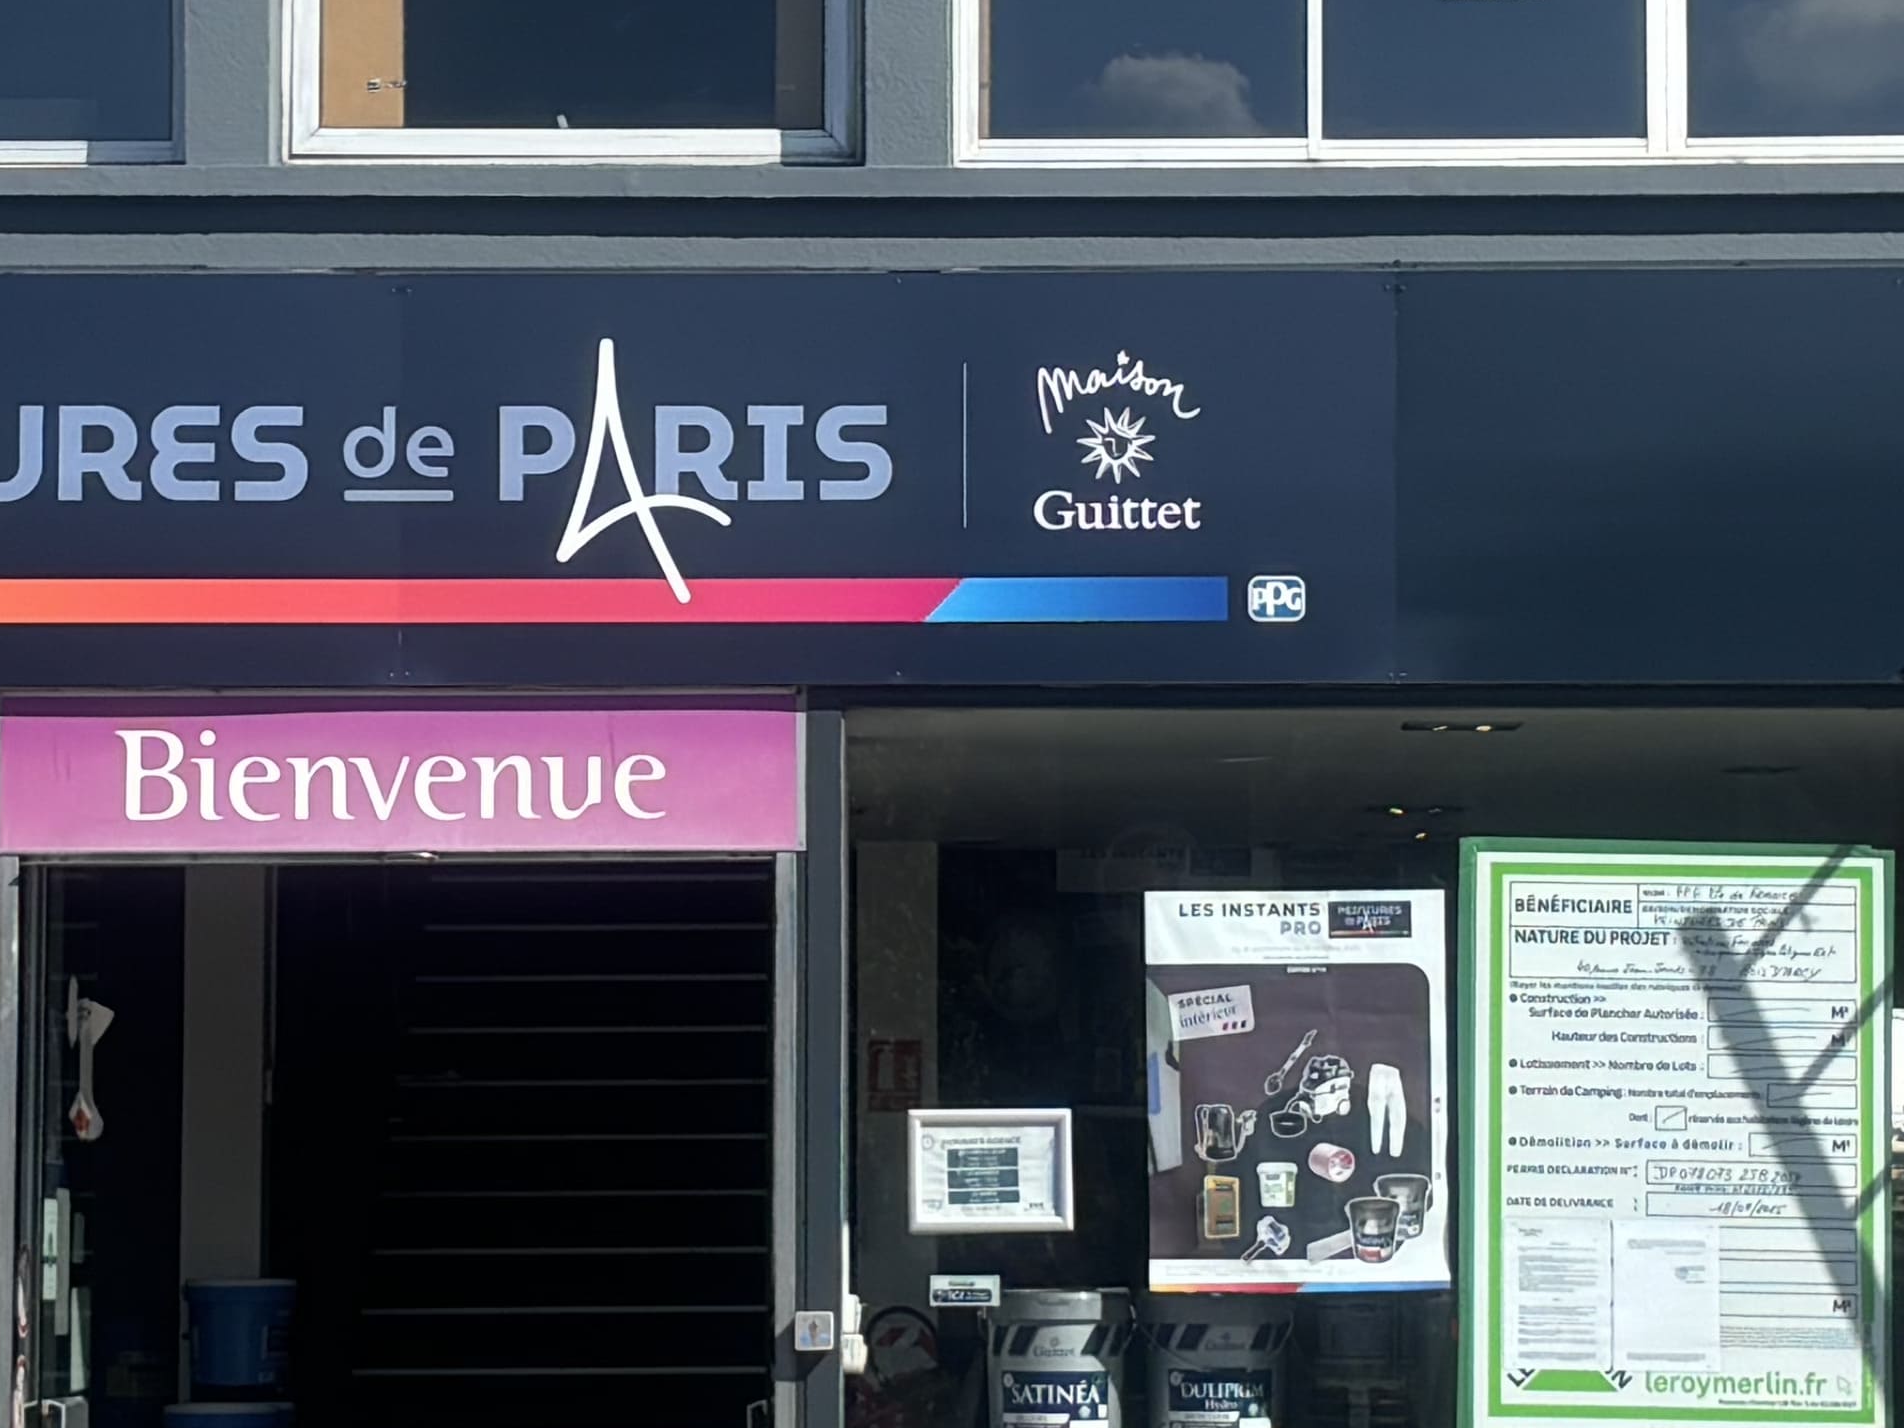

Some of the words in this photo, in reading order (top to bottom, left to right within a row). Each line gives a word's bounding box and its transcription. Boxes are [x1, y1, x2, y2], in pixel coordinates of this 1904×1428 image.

[343, 422, 455, 486] de
[501, 337, 894, 605] PARIS
[1032, 489, 1202, 531] Guittet
[1251, 580, 1302, 617] PPG
[115, 728, 670, 825] Bienvenue
[1178, 903, 1214, 917] LES
[1222, 902, 1321, 917] INSTANTS
[1514, 895, 1633, 915] BÉNÉFICIAIRE
[1280, 920, 1322, 936] PRO
[1514, 929, 1581, 945] NATURE
[1584, 930, 1607, 945] DU
[1609, 931, 1671, 947] PROJET
[1519, 993, 1592, 1005] Construction
[1011, 1379, 1101, 1405] SATINÉA
[1645, 1373, 1828, 1399] leroymerlin.fr
